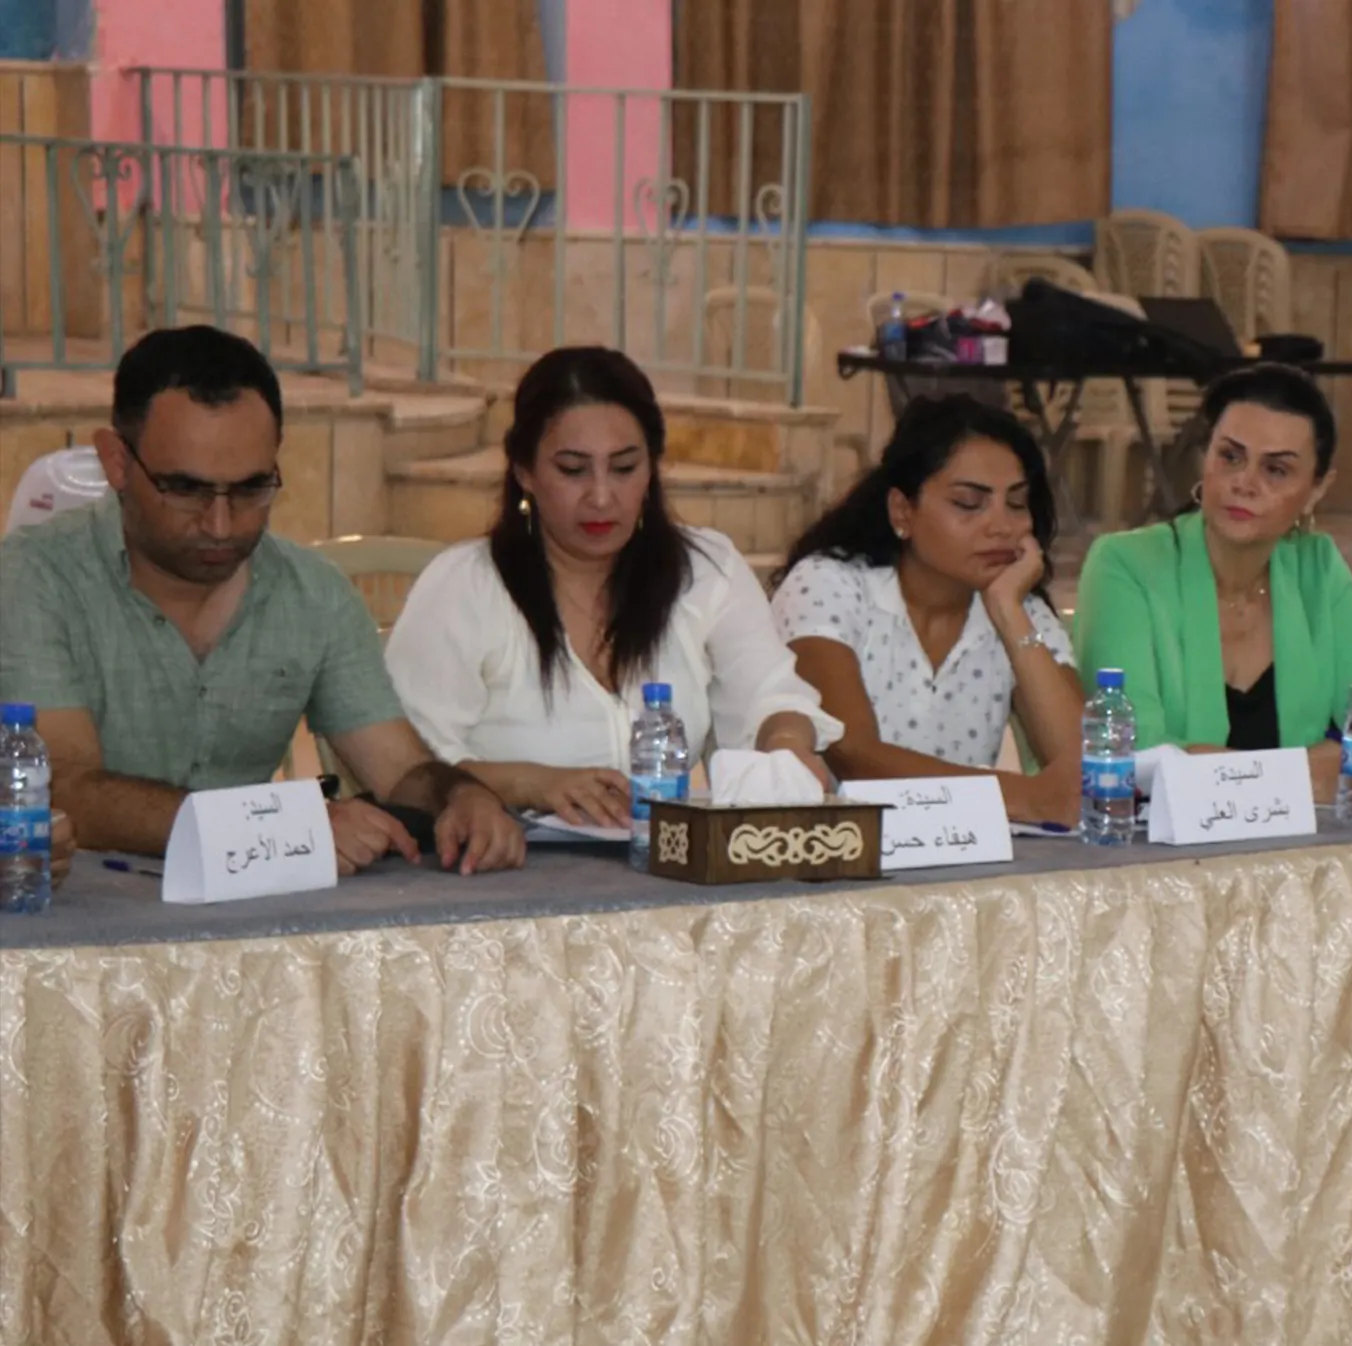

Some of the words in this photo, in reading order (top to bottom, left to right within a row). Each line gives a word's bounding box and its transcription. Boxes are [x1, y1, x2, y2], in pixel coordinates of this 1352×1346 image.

[1213, 759, 1265, 787] السيدة:
[240, 791, 284, 822] السيد:
[898, 784, 953, 812] السيدة:
[1244, 797, 1291, 823] بشرى
[1199, 799, 1238, 831] العلي
[933, 824, 978, 853] هيفاء
